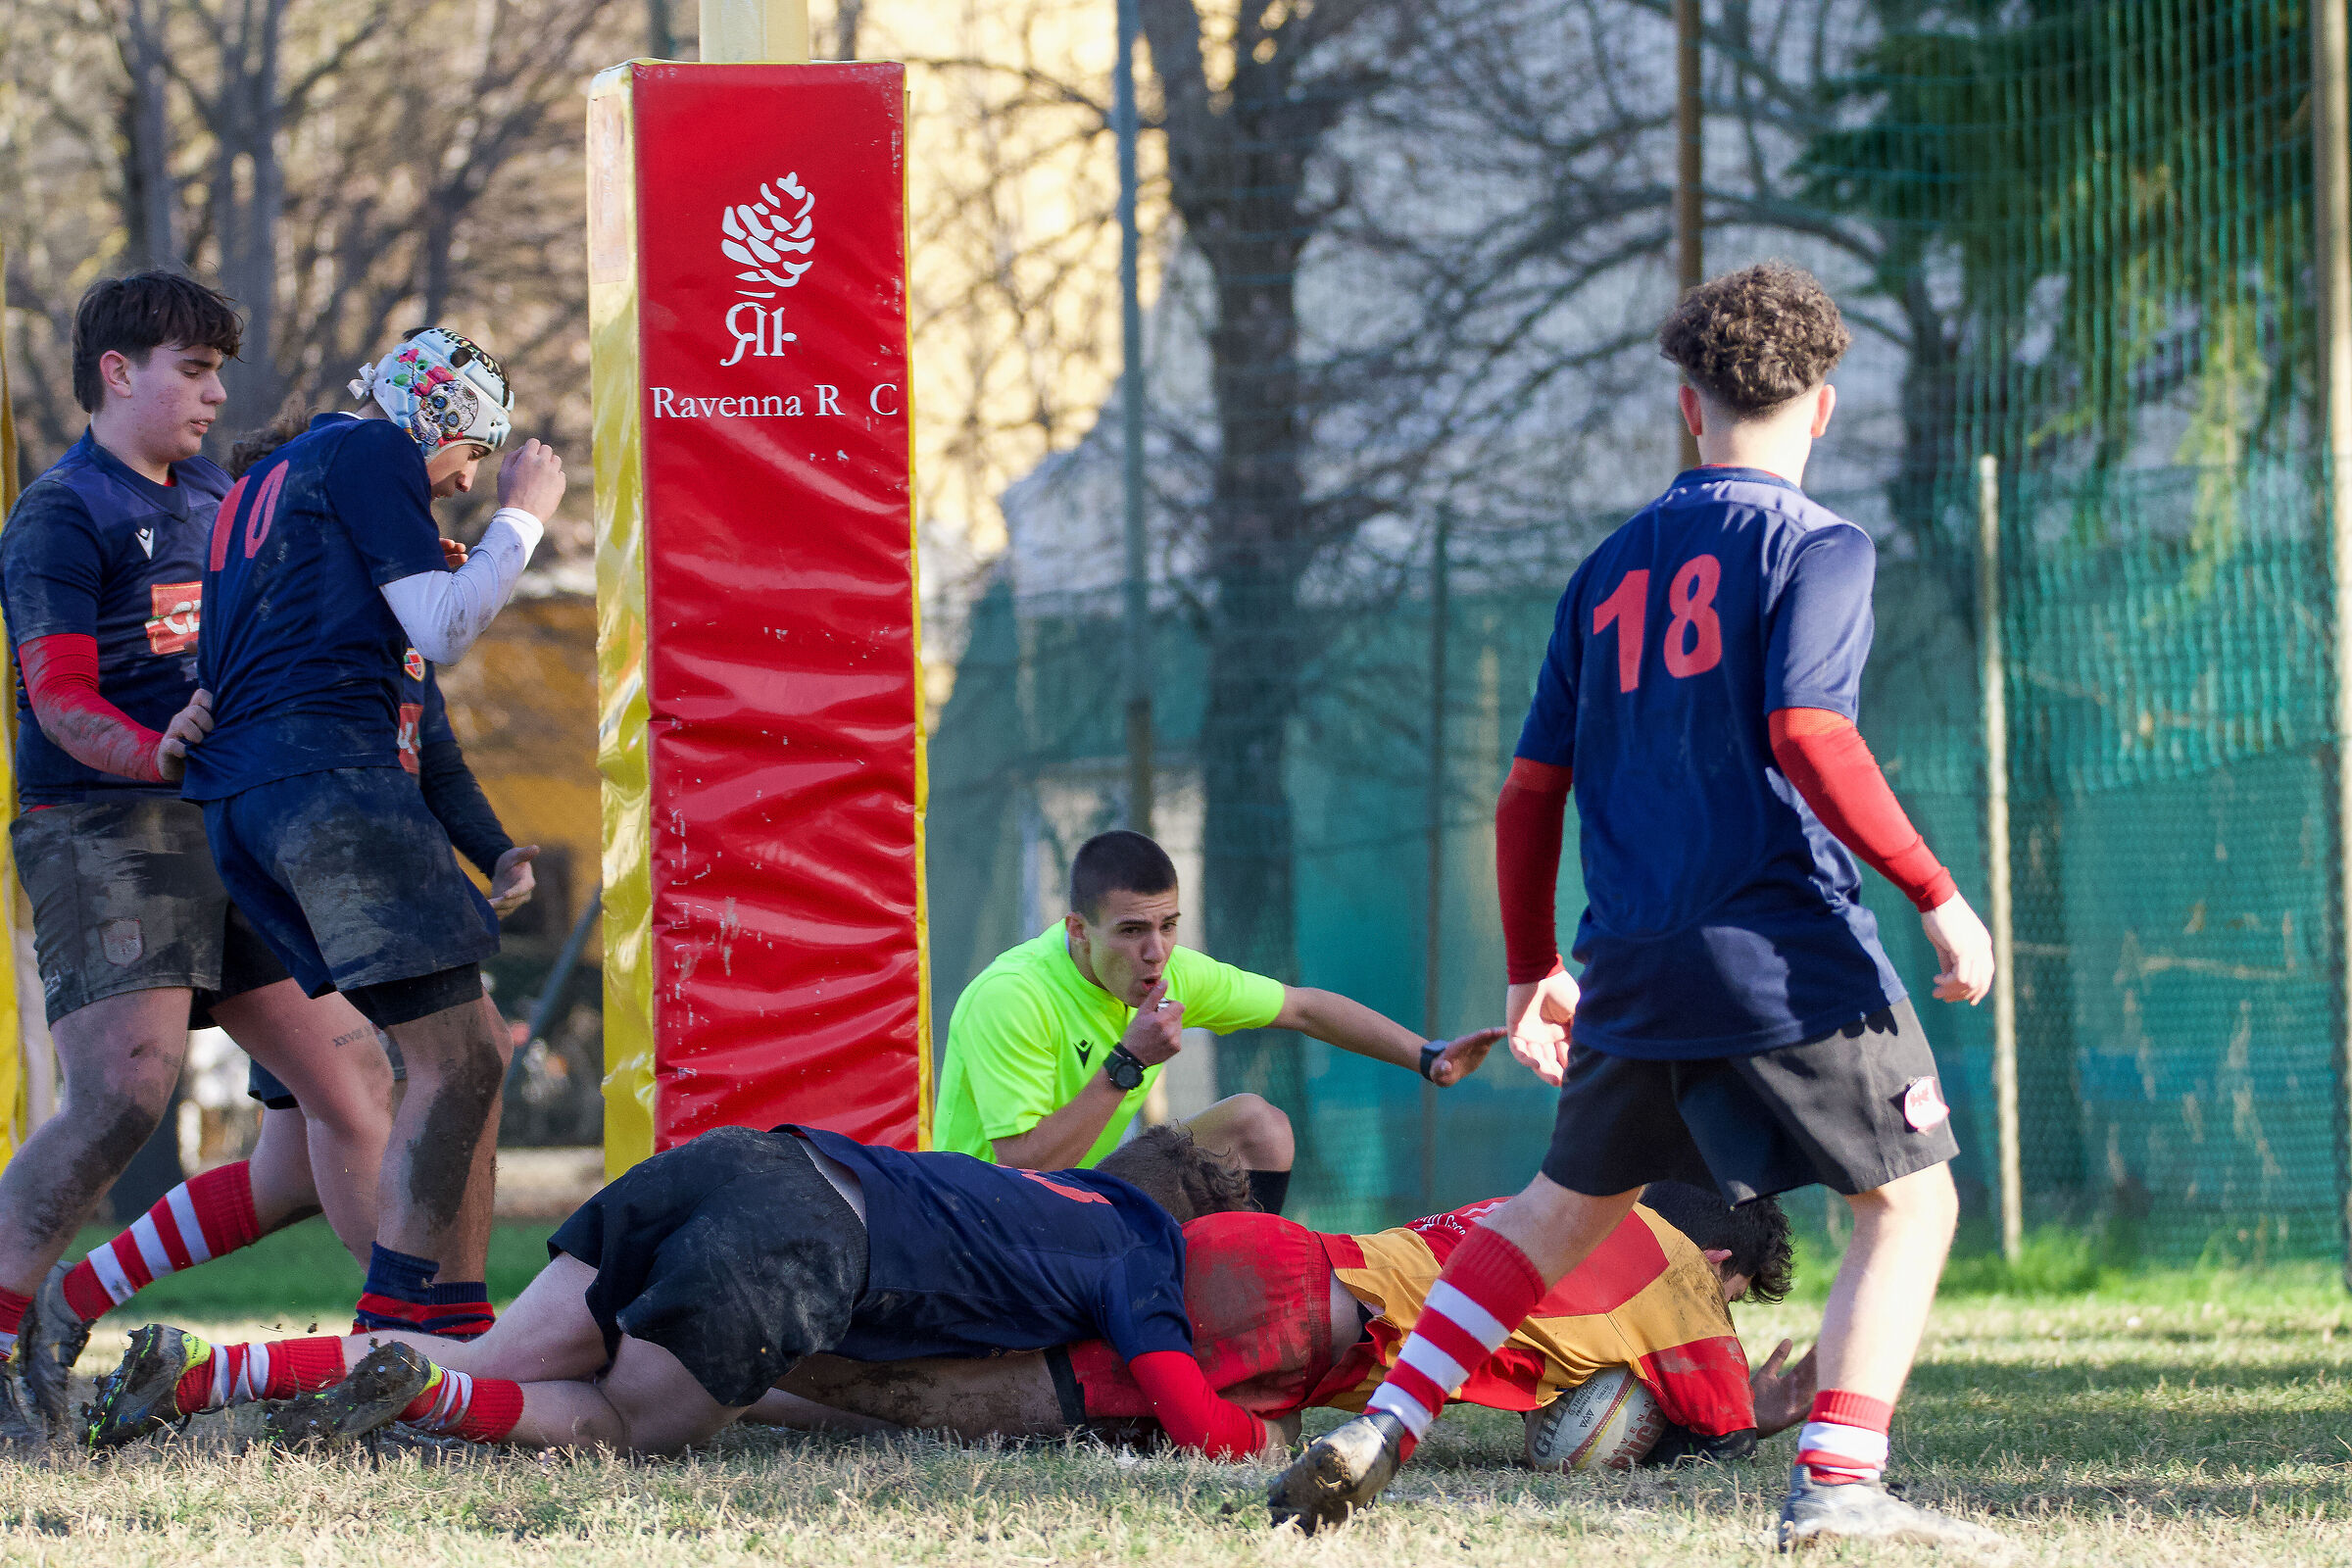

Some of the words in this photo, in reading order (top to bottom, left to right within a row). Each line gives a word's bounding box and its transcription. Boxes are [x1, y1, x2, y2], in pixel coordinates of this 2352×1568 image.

[649, 386, 805, 418] Ravenna
[813, 384, 846, 416] R
[868, 382, 899, 416] C
[209, 459, 290, 572] 10
[1592, 553, 1723, 694] 18
[1599, 1399, 1653, 1465] RAVENN
